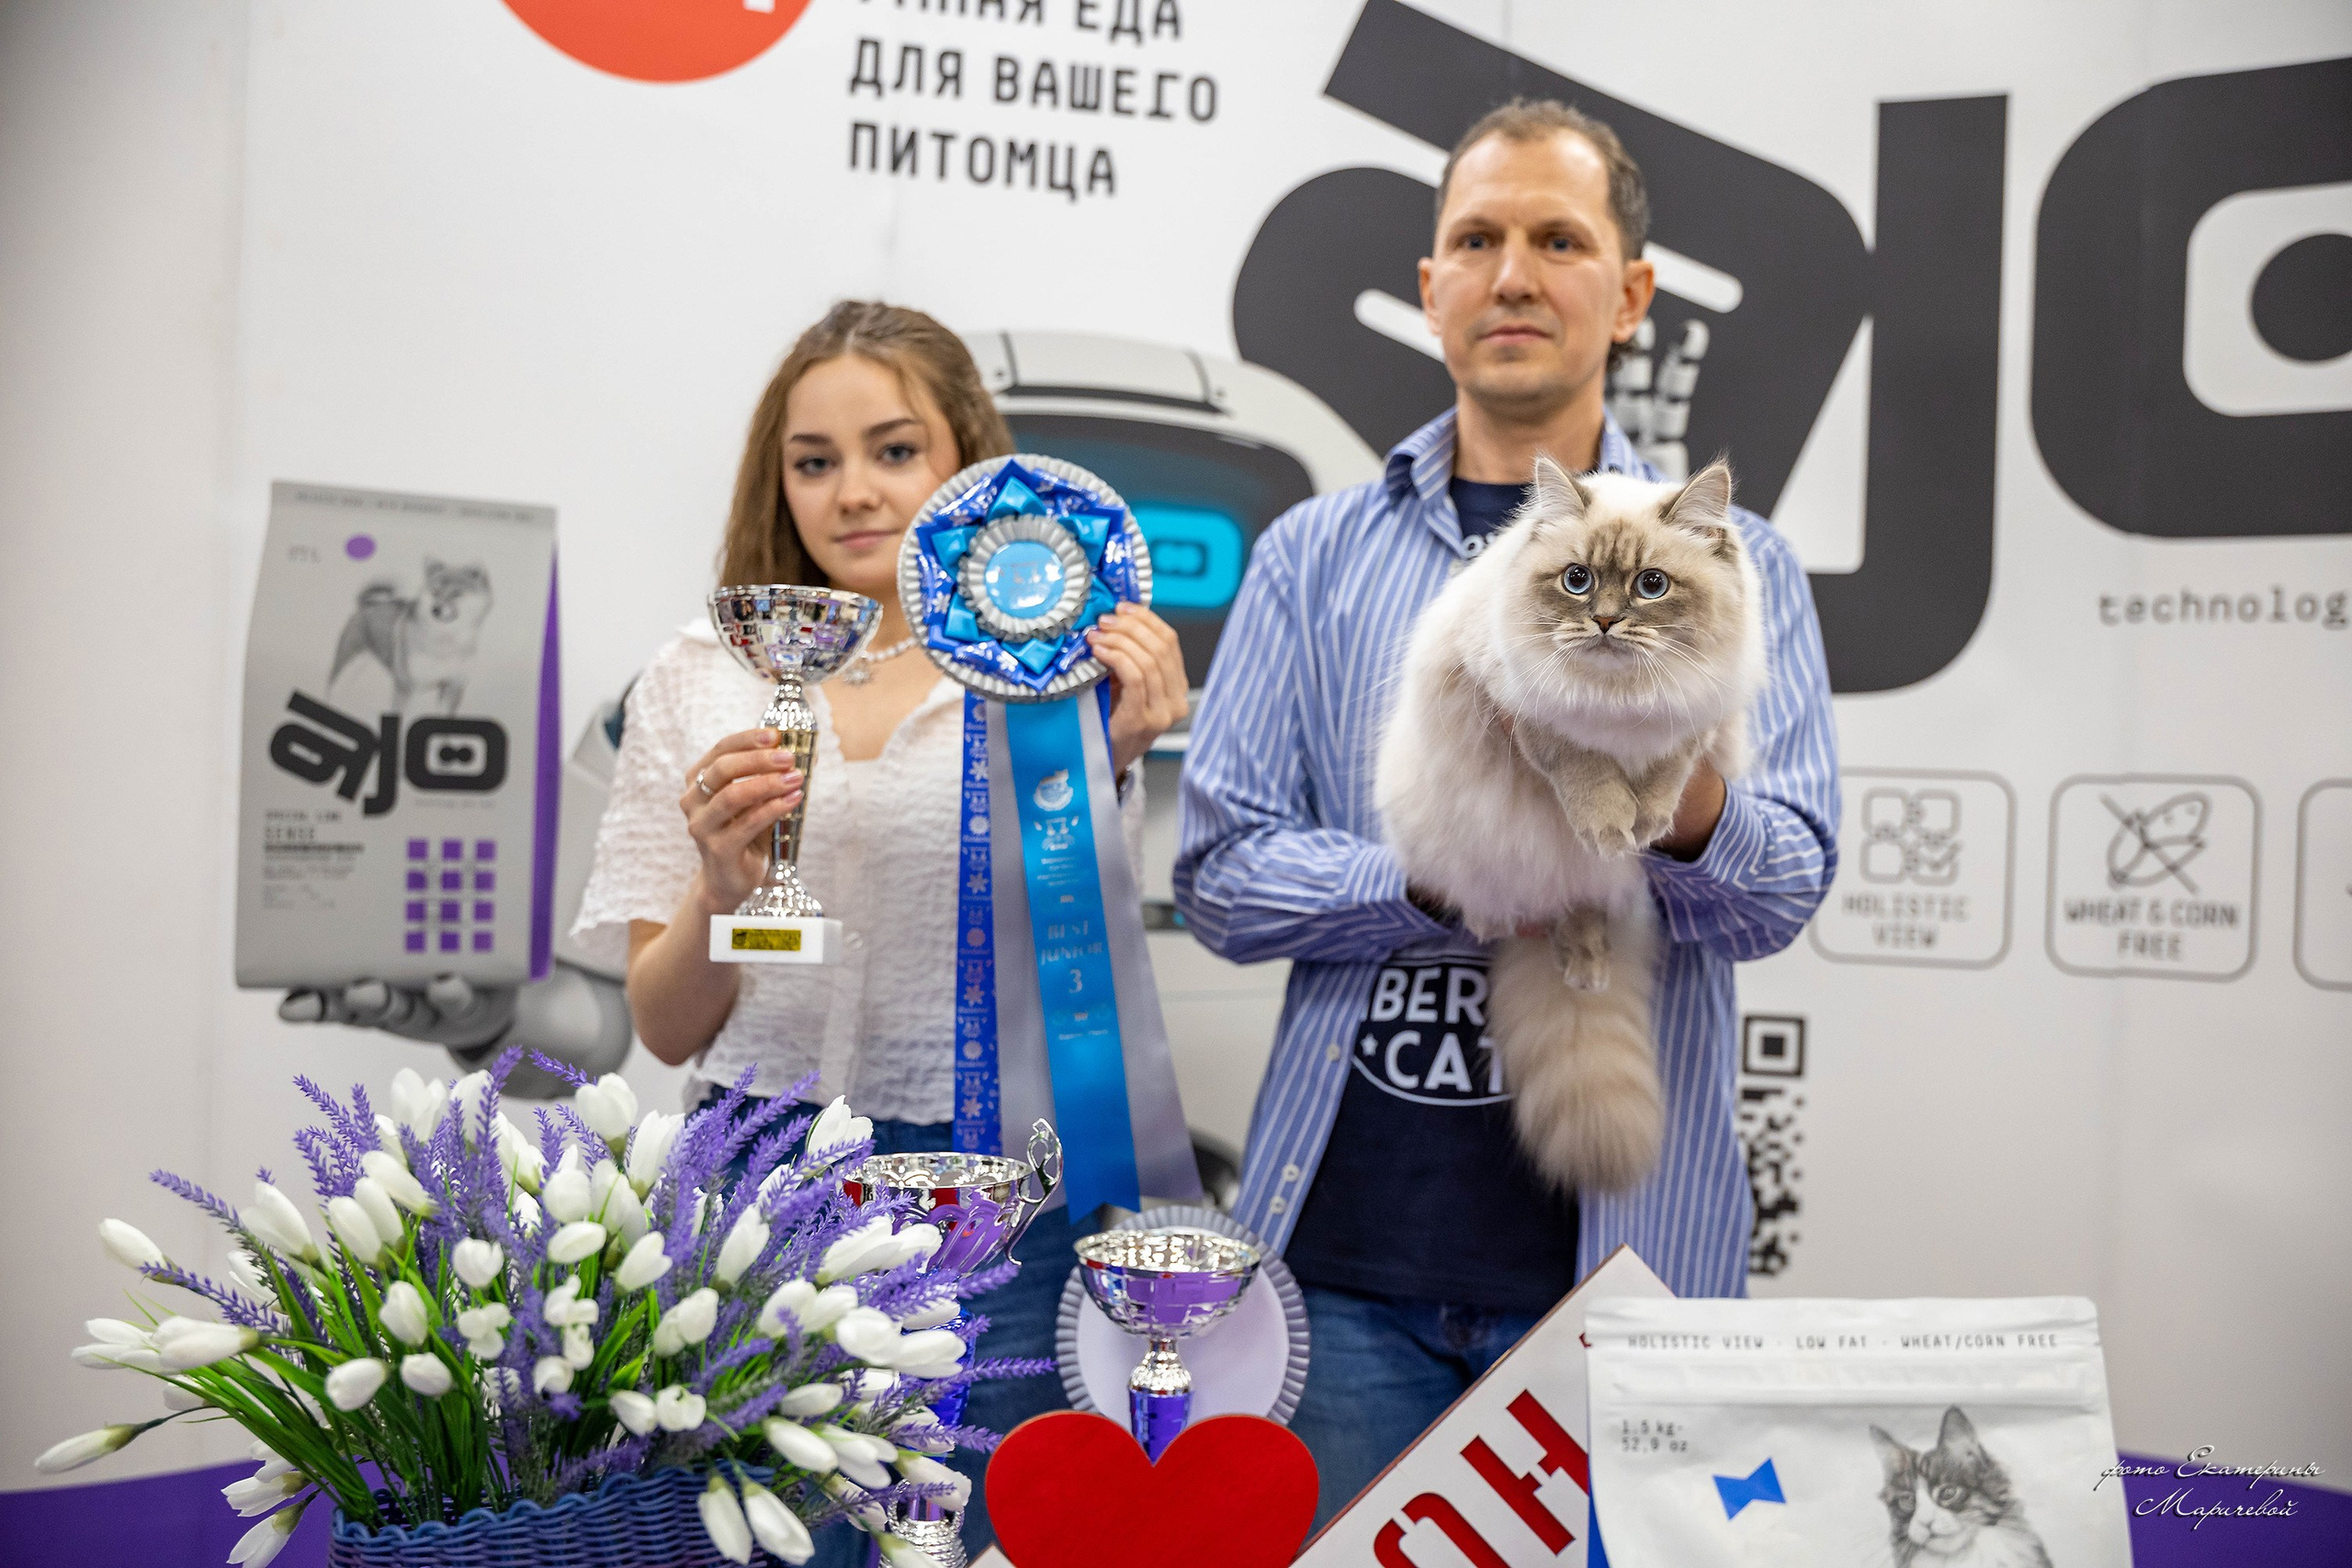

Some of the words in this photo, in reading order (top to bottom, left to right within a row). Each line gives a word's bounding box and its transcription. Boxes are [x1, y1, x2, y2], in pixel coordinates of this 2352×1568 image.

[1076, 0, 1182, 45] ЕДА
[849, 38, 963, 100] ДЛЯ
[993, 55, 1217, 122] ВАШЕГО
[849, 121, 1117, 200] ПИТОМЦА
[2098, 586, 2349, 630] technolog
[1842, 891, 1971, 922] HOLISTIC
[2064, 897, 2142, 924] WHEAT
[2169, 898, 2240, 928] CORN
[1872, 921, 1939, 949] VIEW
[2117, 929, 2184, 961] FREE
[1068, 968, 1083, 994] 3
[1360, 966, 1489, 1026] BER
[1384, 1030, 1504, 1094] CAT
[1627, 1334, 1711, 1349] HOLISTIC
[1722, 1334, 1764, 1349] VIEW
[1795, 1334, 1826, 1349] LOW
[1838, 1334, 1867, 1349] FAT
[1900, 1333, 2006, 1350] WHEAT/CORN
[2017, 1333, 2058, 1348] FREE
